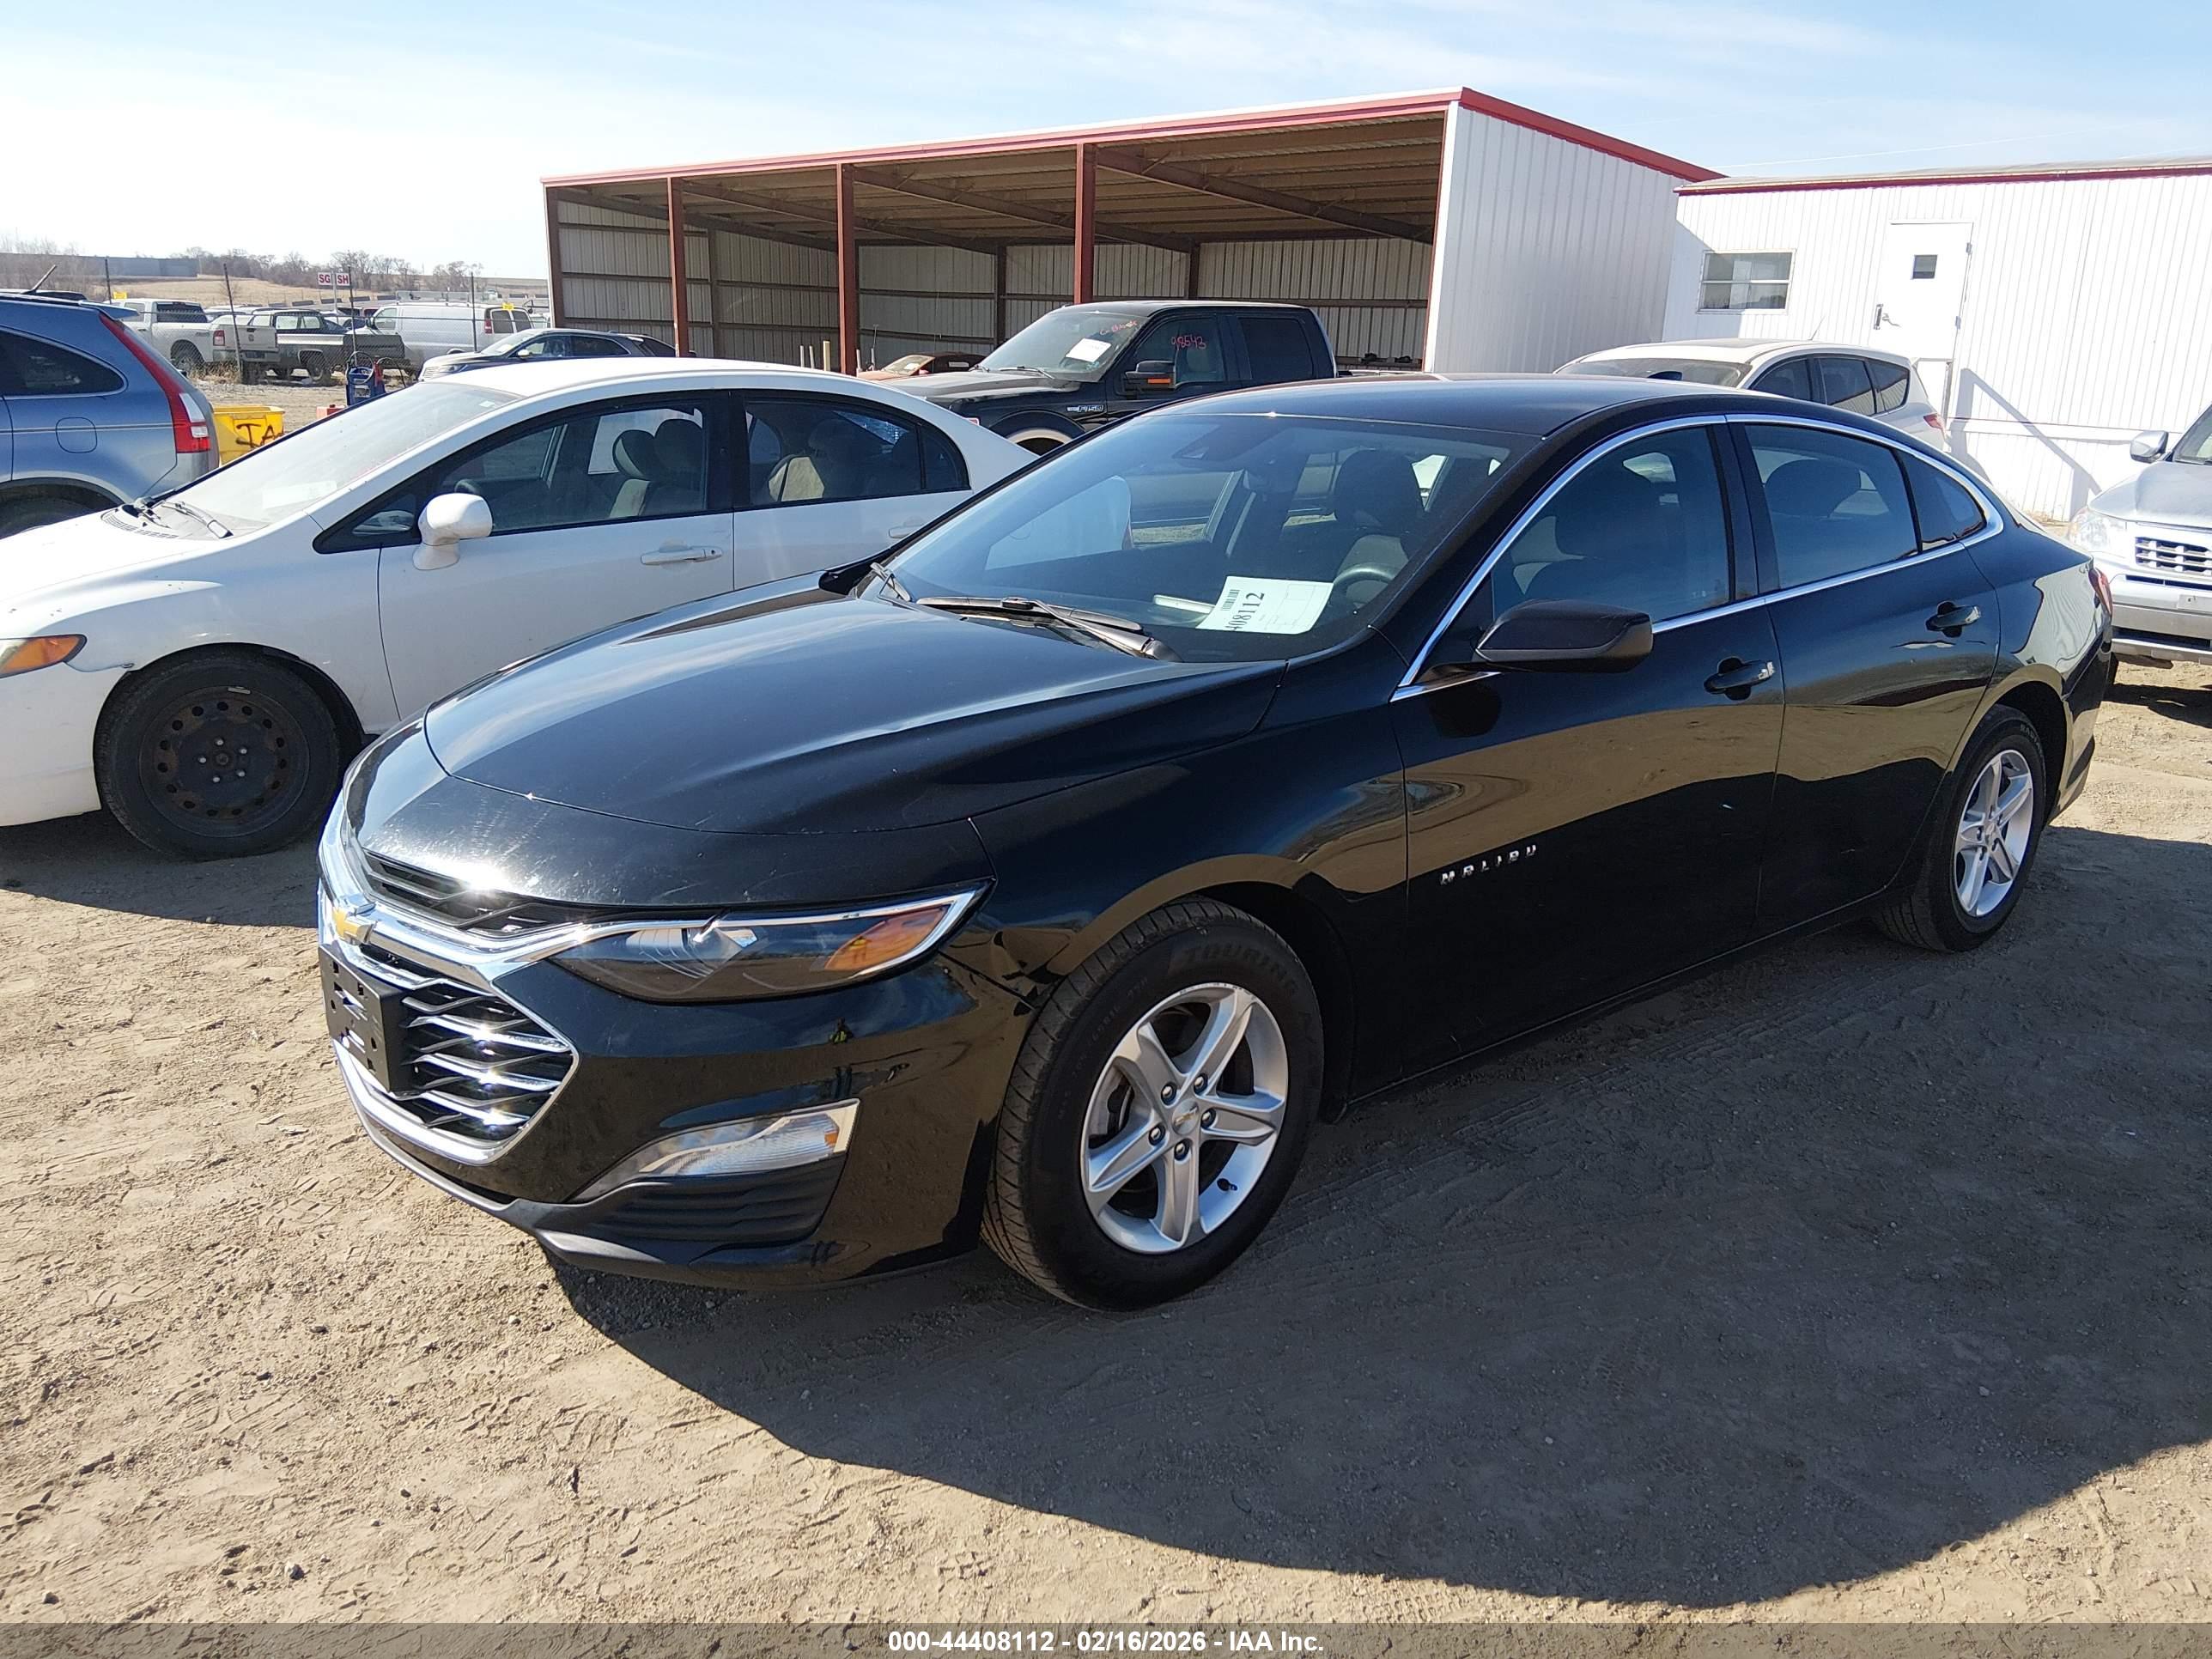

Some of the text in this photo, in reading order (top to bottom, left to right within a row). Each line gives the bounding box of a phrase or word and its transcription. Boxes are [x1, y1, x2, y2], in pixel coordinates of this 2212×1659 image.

[319, 274, 331, 283] SG
[337, 274, 349, 284] SH
[1440, 844, 1537, 885] MALIBU
